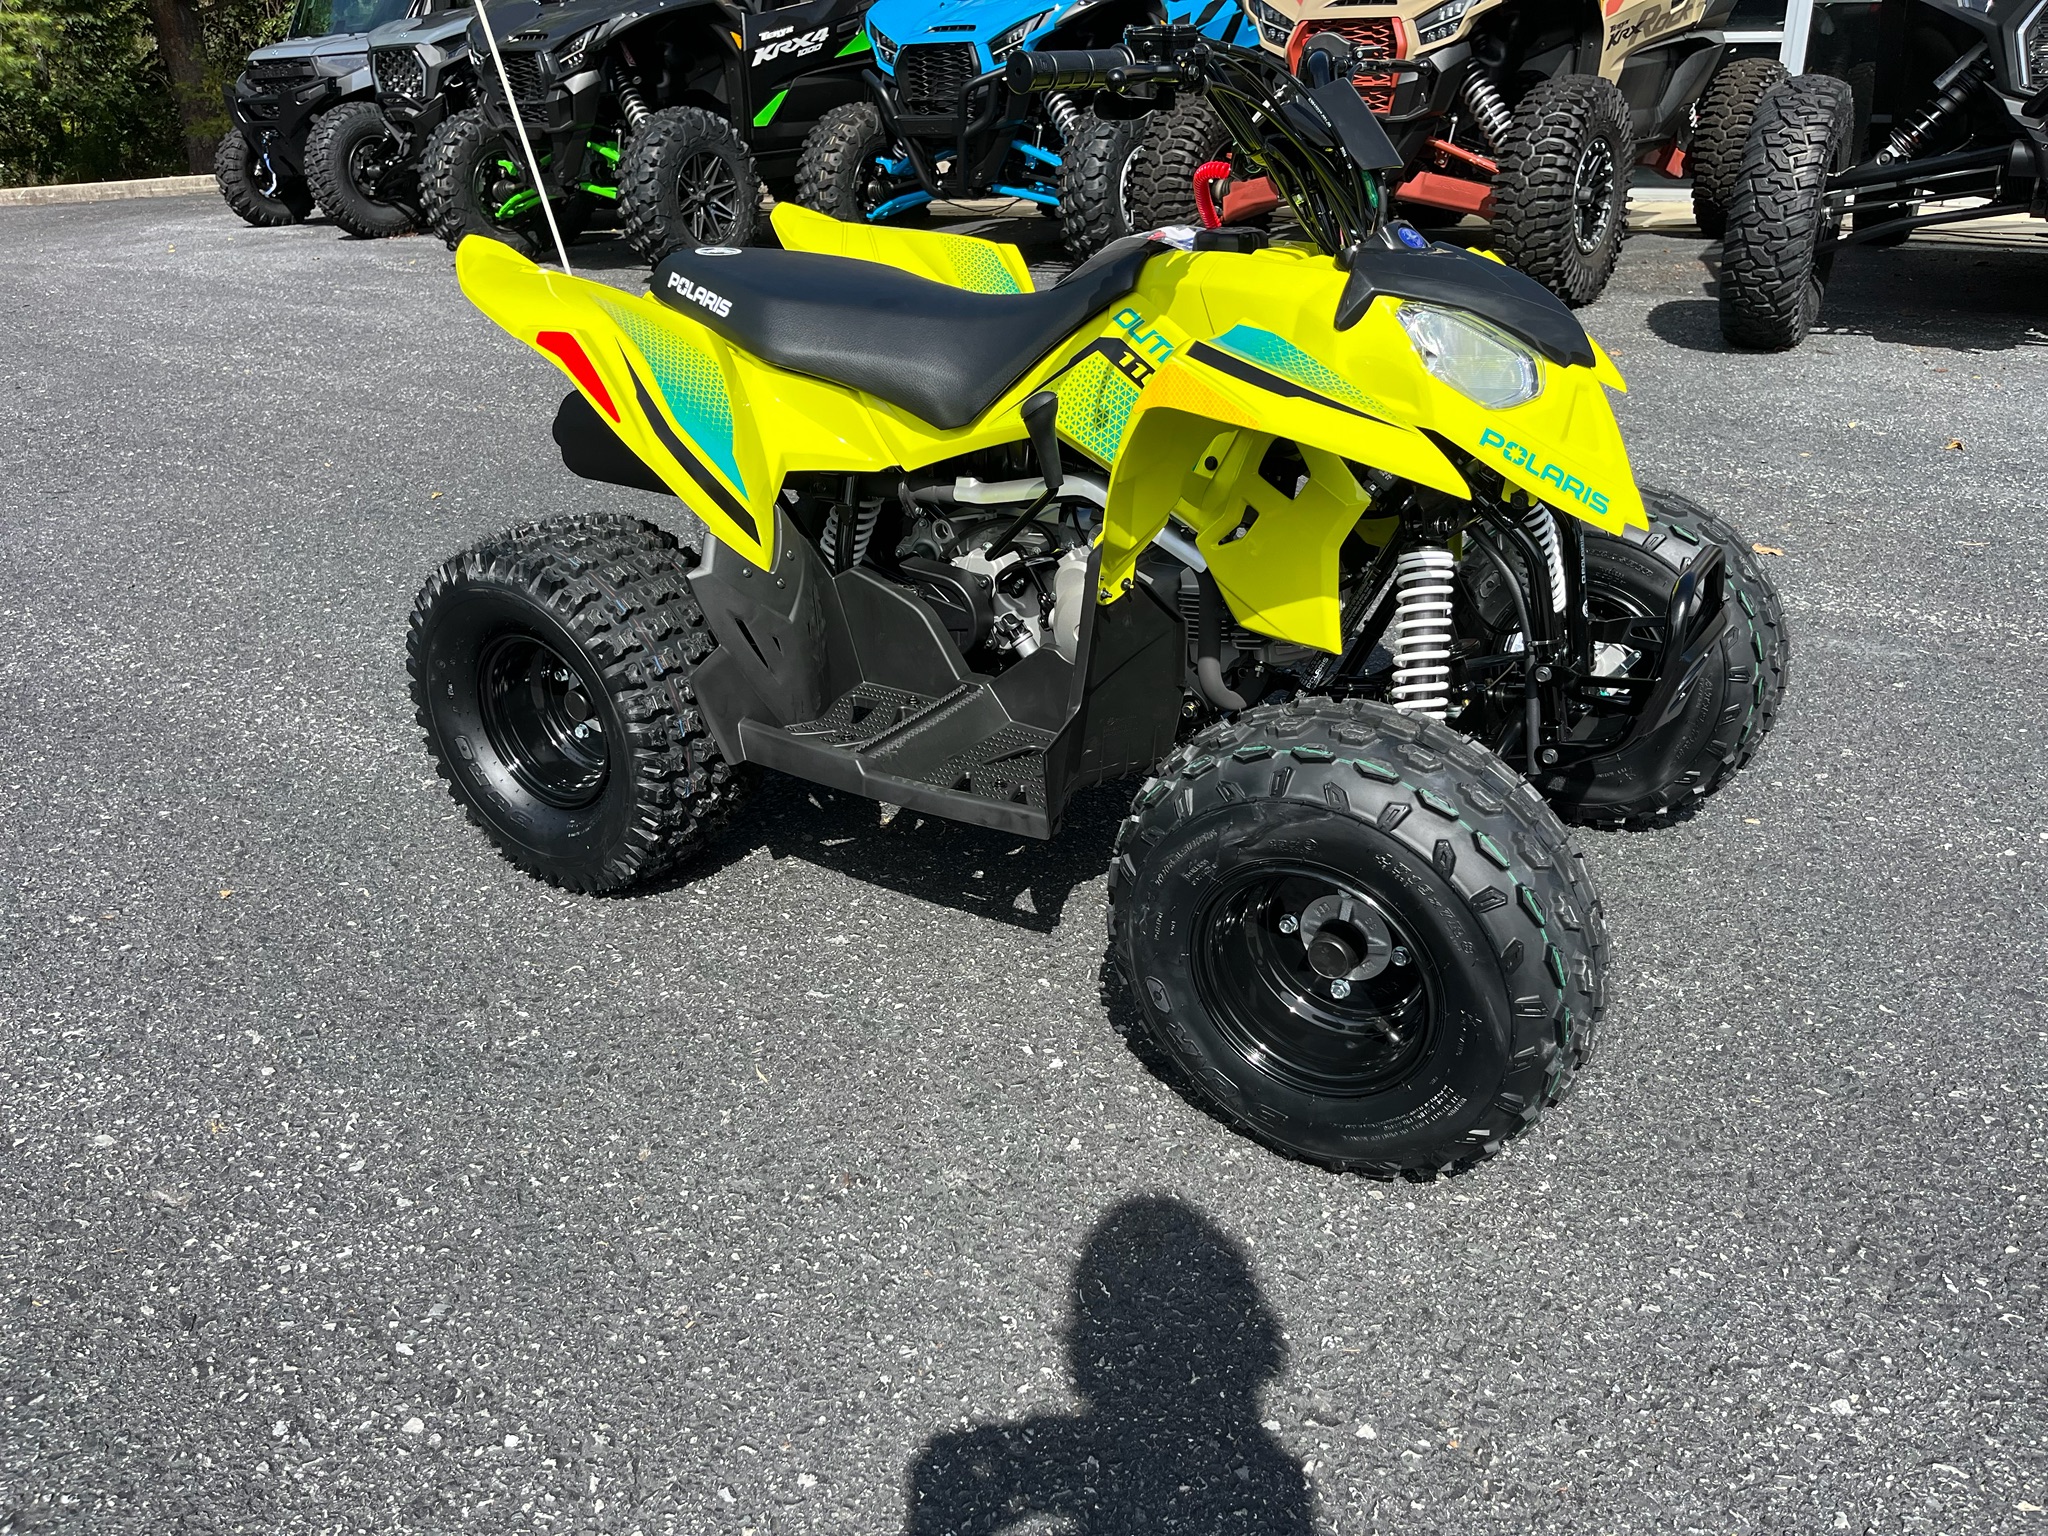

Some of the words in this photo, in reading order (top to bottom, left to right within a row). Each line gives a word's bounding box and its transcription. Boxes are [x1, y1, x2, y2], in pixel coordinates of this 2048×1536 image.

[751, 27, 830, 67] KRX4
[797, 43, 823, 57] 1000
[1605, 20, 1646, 51] KRX
[667, 271, 733, 318] POLARIS
[1479, 427, 1610, 515] POLARIS
